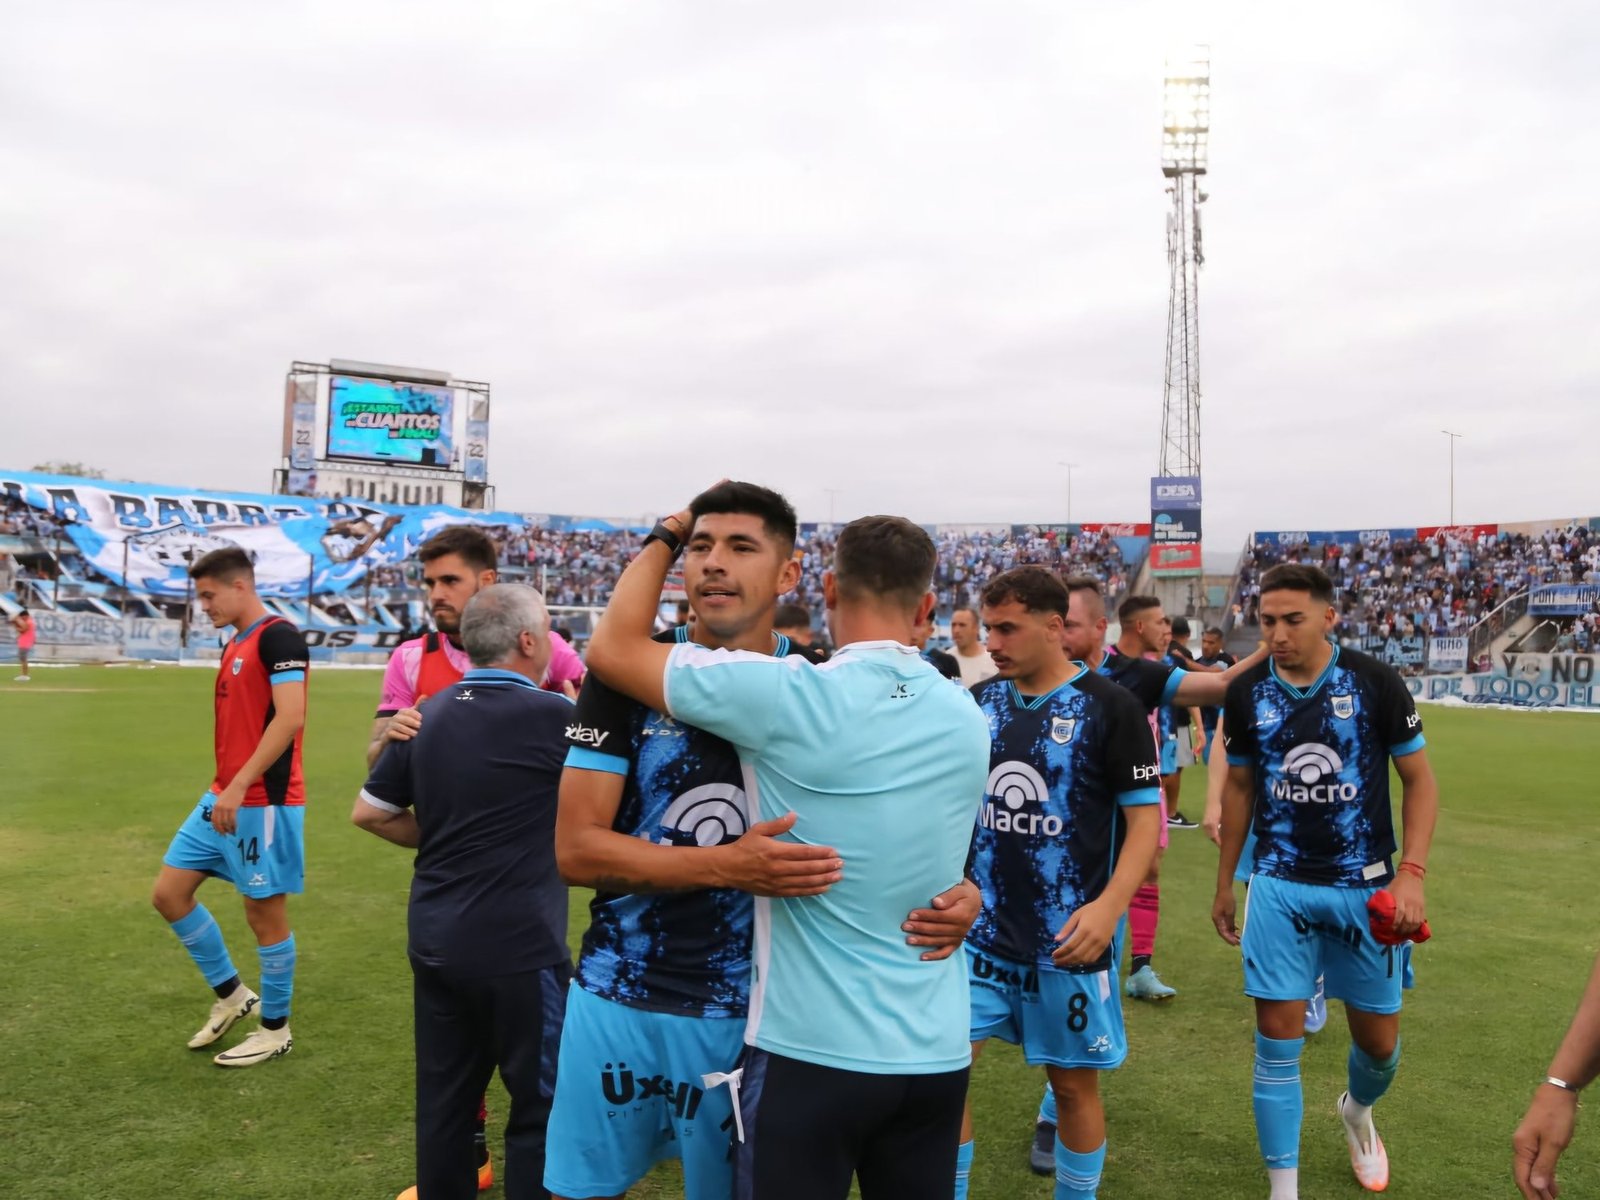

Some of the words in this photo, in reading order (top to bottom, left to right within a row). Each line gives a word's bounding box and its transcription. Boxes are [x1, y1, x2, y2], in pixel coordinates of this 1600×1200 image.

[1551, 655, 1595, 684] NO
[1271, 778, 1358, 804] Macro
[979, 801, 1064, 837] Macro
[237, 836, 261, 867] 14
[1066, 992, 1089, 1033] 8
